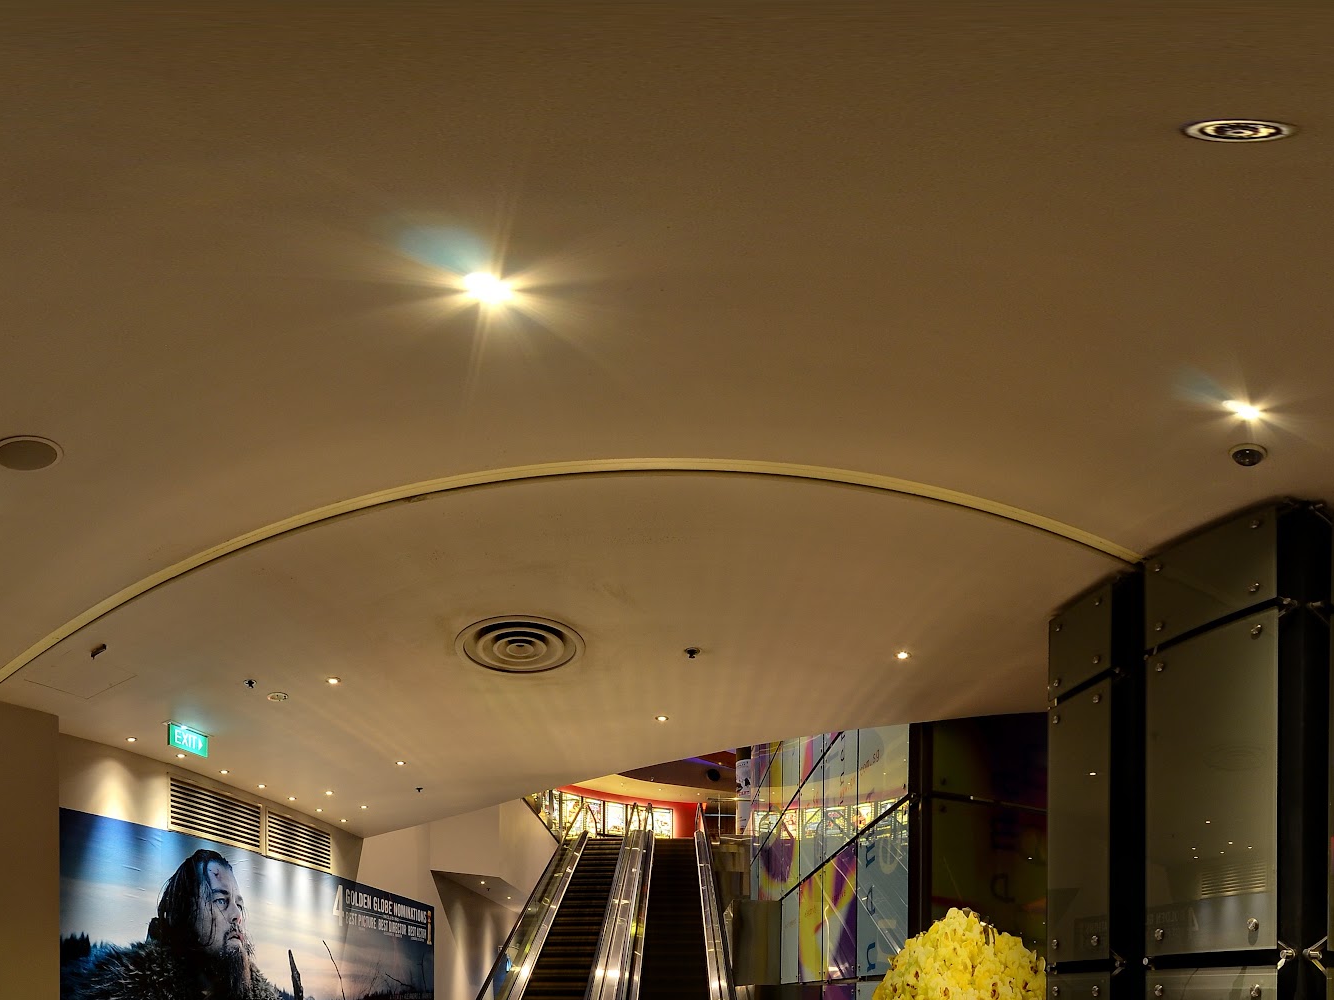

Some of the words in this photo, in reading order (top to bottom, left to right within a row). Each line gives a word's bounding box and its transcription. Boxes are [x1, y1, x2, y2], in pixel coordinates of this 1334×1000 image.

[174, 728, 197, 749] EXIT
[332, 884, 344, 926] 4
[345, 889, 371, 910] GOLDEN
[373, 897, 393, 914] GLOBE
[393, 903, 426, 923] NOMINATIONS
[346, 912, 358, 926] BEST
[358, 914, 376, 929] PICTURE
[378, 919, 387, 931] BEST
[388, 921, 407, 935] DIRECTOR
[407, 925, 416, 936] BEST
